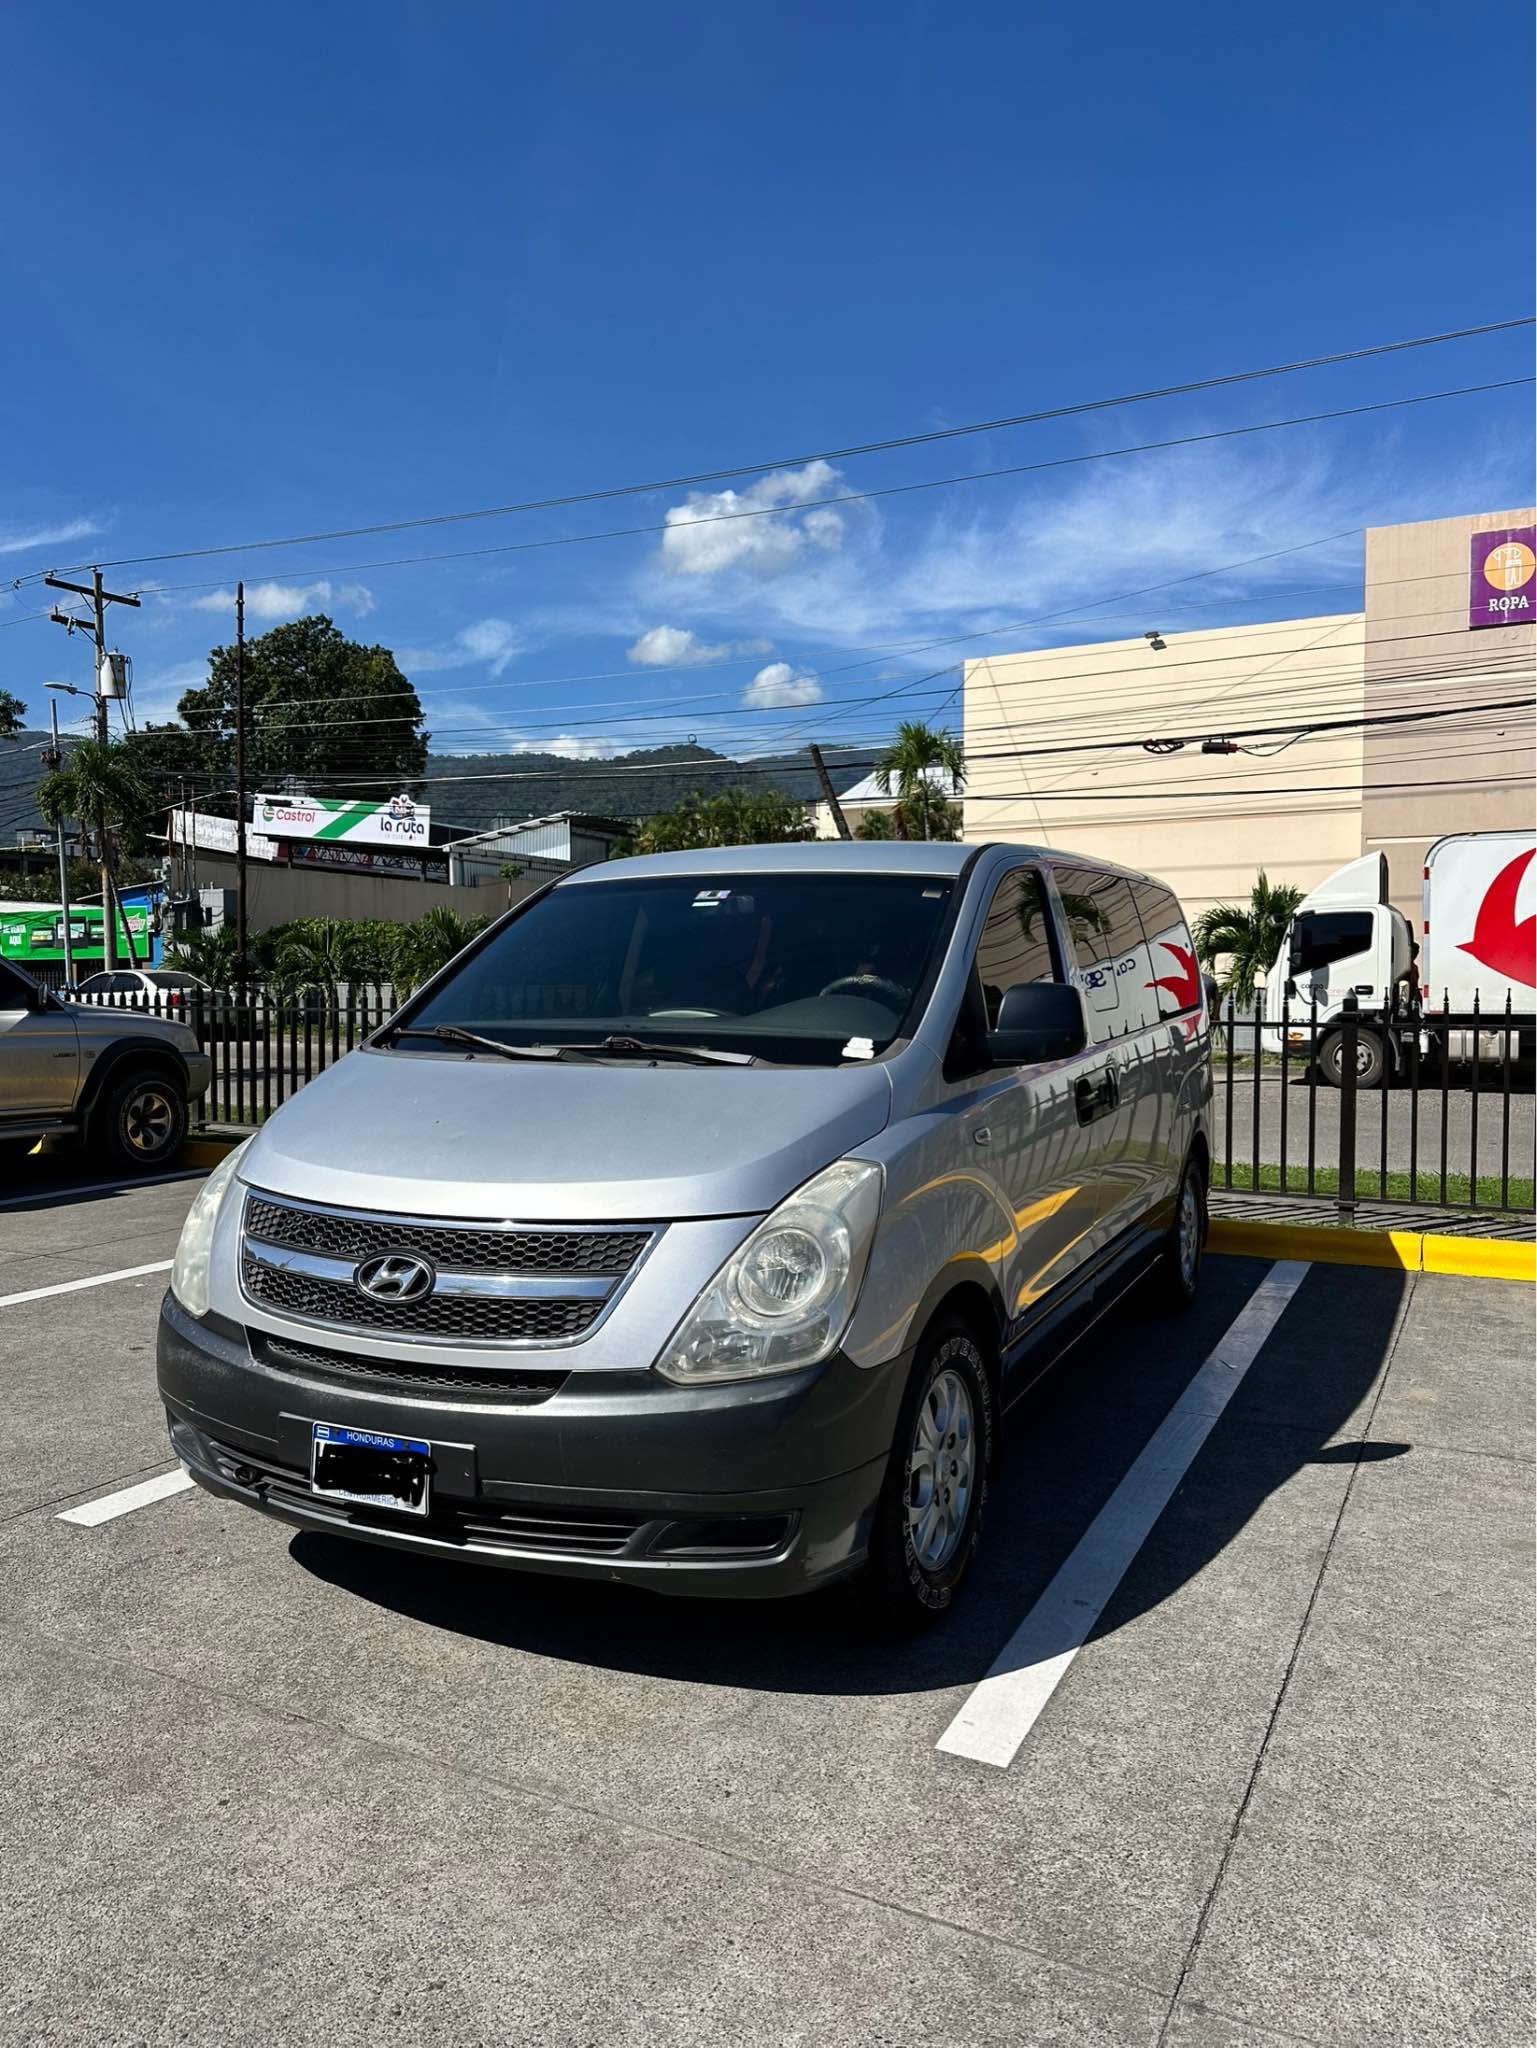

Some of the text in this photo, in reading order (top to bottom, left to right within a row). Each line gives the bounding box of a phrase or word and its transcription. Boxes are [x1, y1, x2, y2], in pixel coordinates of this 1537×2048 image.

[1488, 595, 1529, 611] ROPA
[276, 808, 316, 823] Castrol
[380, 817, 425, 835] la ruta
[346, 1431, 395, 1448] HONDURAS
